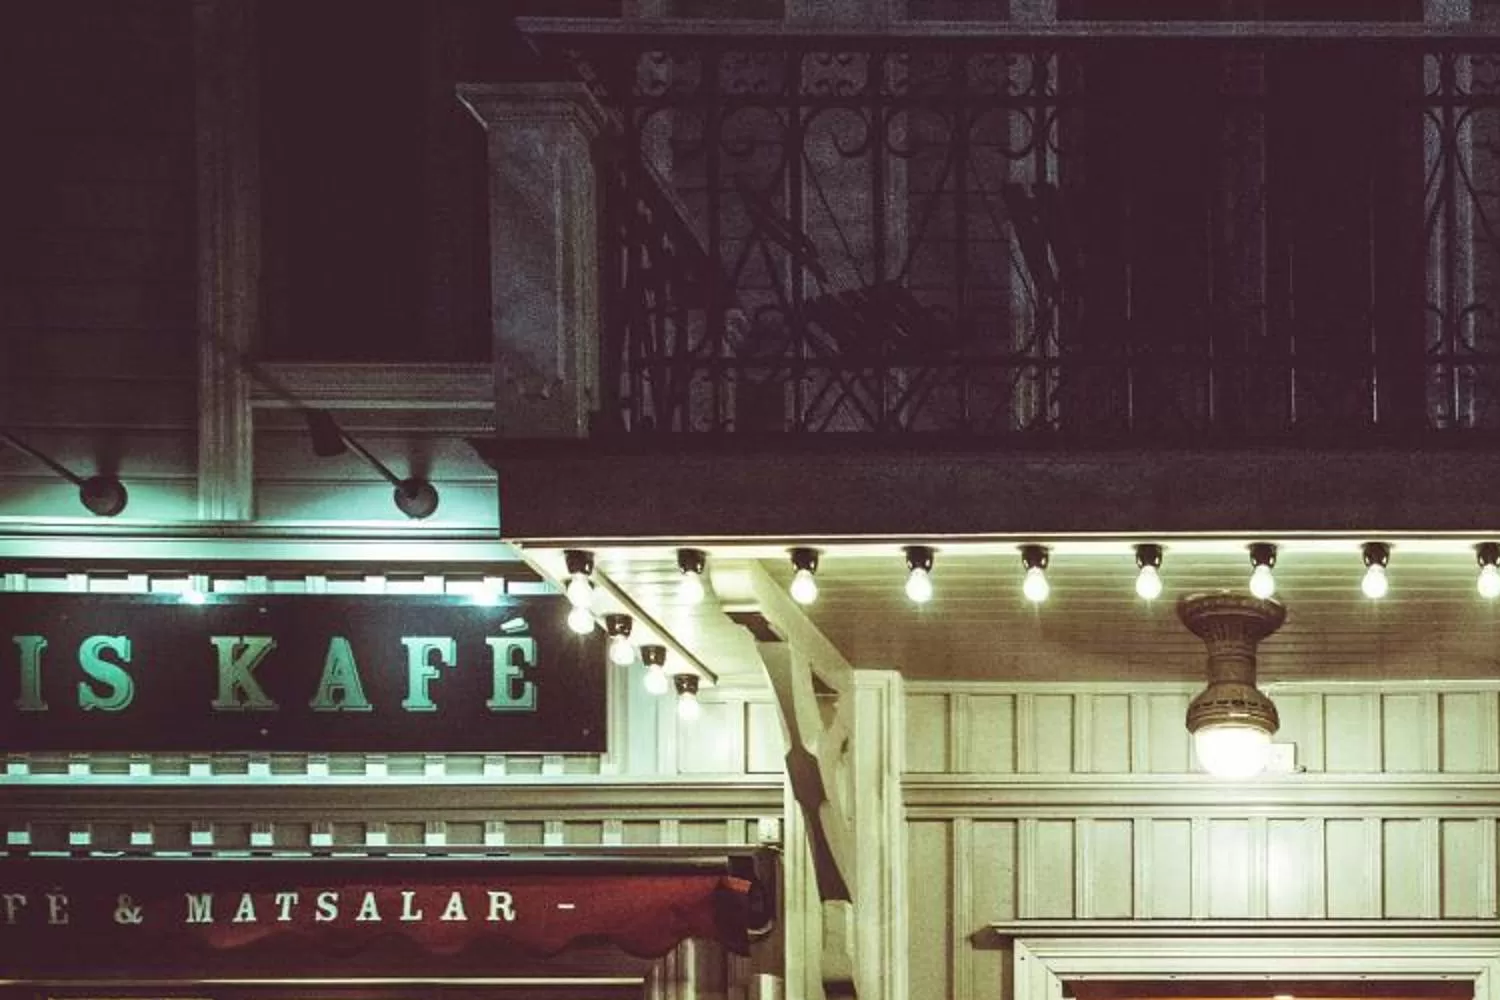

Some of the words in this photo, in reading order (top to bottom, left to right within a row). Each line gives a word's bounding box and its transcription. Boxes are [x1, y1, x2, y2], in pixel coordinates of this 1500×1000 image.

[209, 615, 538, 712] KAFÉ
[112, 893, 144, 925] &
[184, 890, 517, 924] MATSALAR
